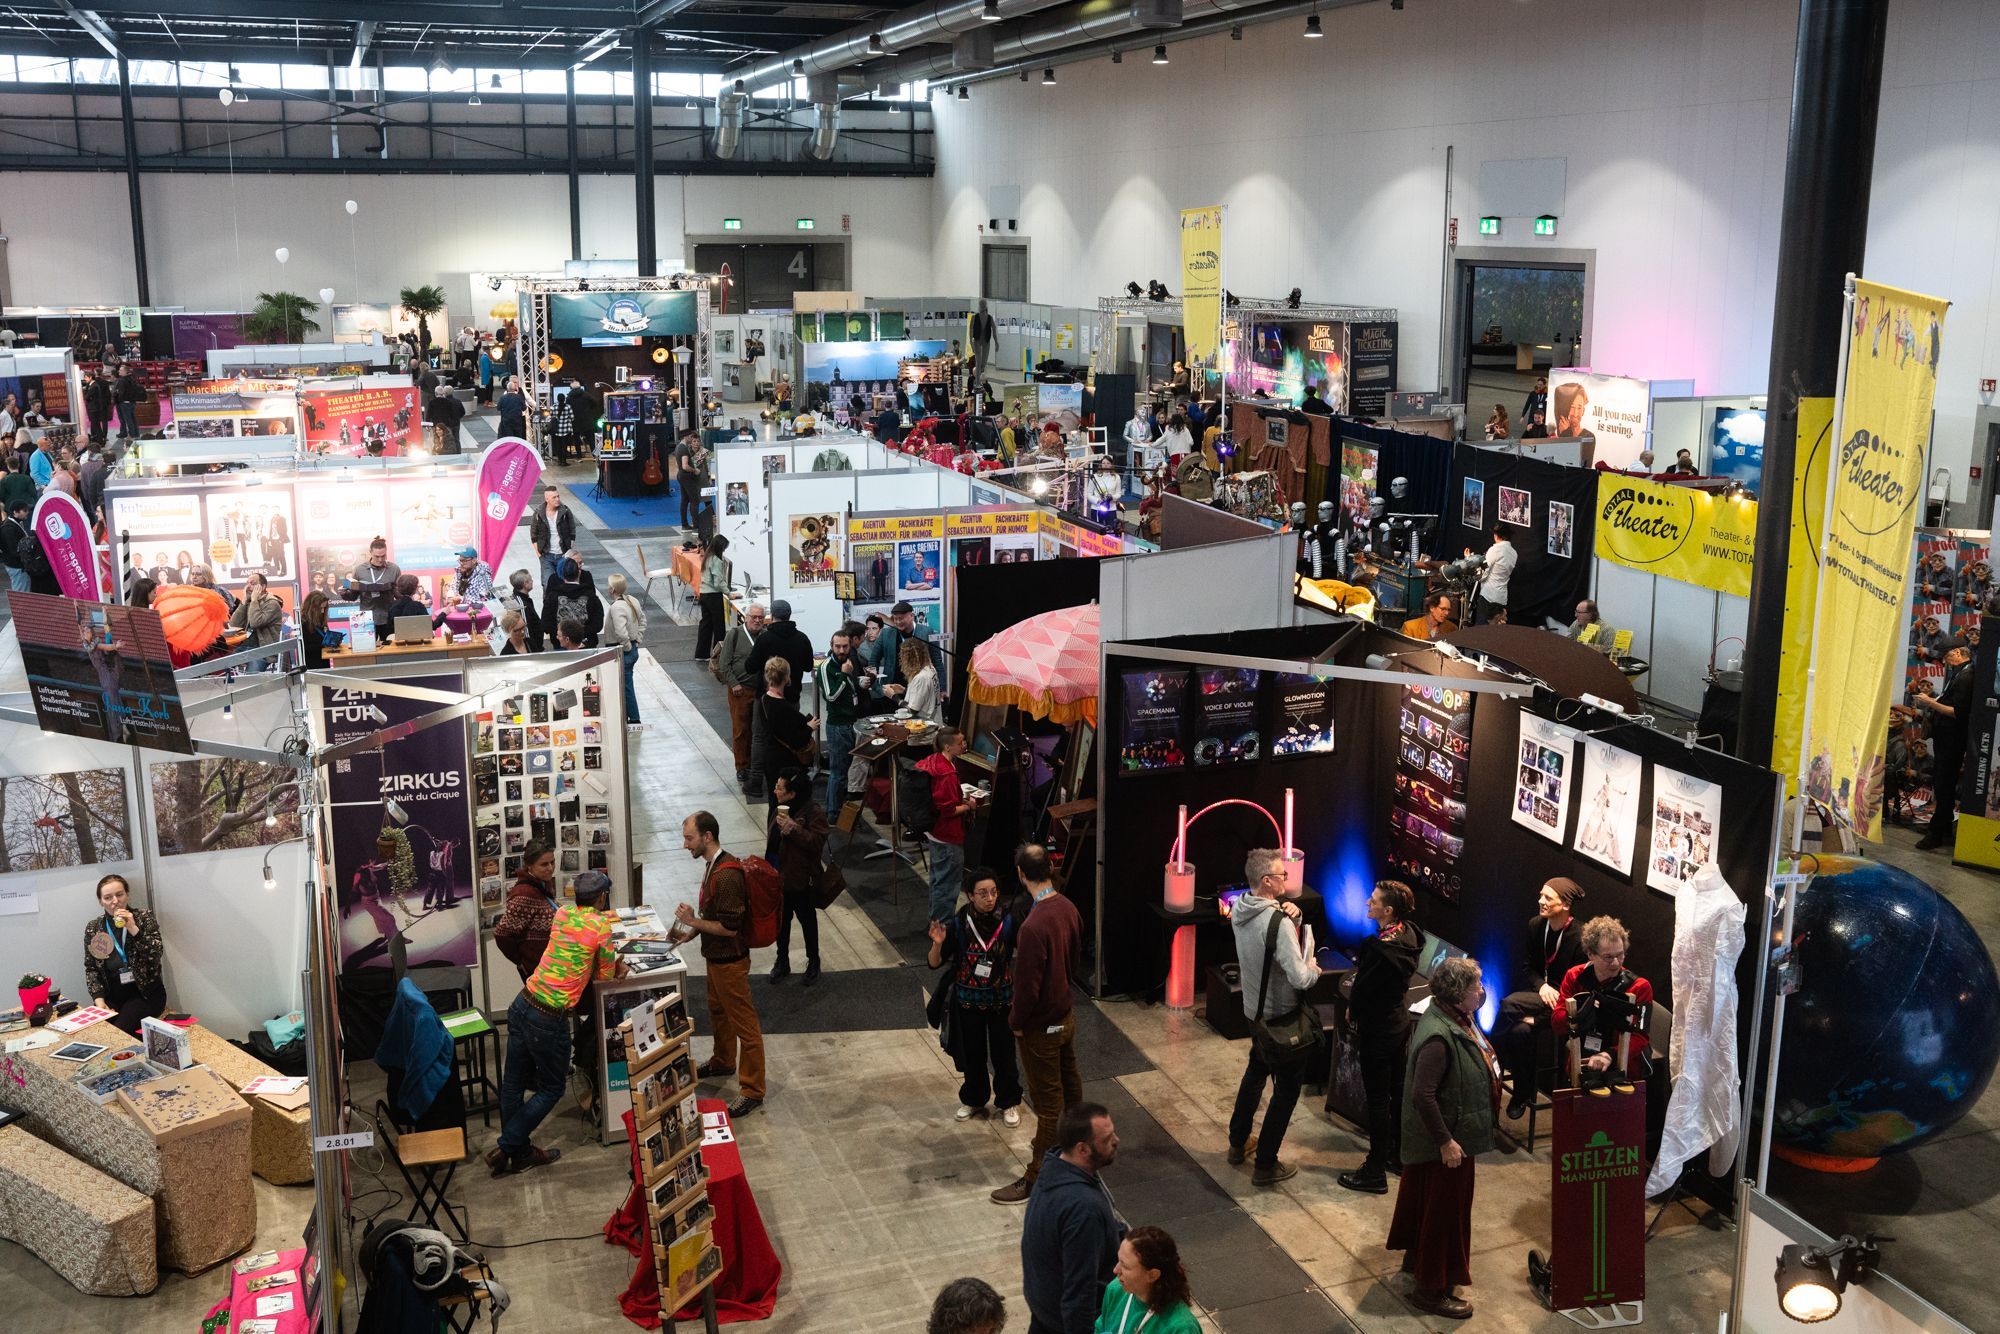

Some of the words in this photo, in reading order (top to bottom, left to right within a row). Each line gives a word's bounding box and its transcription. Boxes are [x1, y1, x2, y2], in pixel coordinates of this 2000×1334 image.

[788, 251, 807, 278] 4
[1363, 328, 1386, 340] MAGIC
[1308, 334, 1334, 350] TICKETING
[1355, 338, 1393, 350] TICKETING
[187, 386, 210, 394] Marc
[327, 393, 364, 405] THEATER
[1592, 406, 1604, 416] All
[1605, 410, 1620, 421] you
[1622, 411, 1642, 424] need
[1597, 420, 1605, 431] is
[1607, 423, 1633, 438] swing.
[499, 455, 520, 494] magenta
[508, 459, 528, 497] ARTISTS
[1849, 450, 1903, 506] theater
[1604, 490, 1632, 517] TOTAAL
[862, 519, 886, 529] AGENTUR
[899, 518, 934, 529] FACHKRÄFTE
[960, 514, 983, 523] AGENTUR
[996, 513, 1029, 523] FACHKRÄFTE
[1613, 503, 1679, 541] theater
[849, 531, 878, 541] SEBASTIAN
[879, 530, 897, 540] KNOCH
[899, 529, 911, 539] FÜR
[912, 529, 933, 539] HUMOR
[947, 526, 975, 536] SEBASTIAN
[976, 525, 993, 535] KNOCH
[996, 525, 1007, 534] FÜR
[1008, 524, 1028, 534] HUMOR
[1710, 526, 1743, 542] Theater-
[1744, 535, 1752, 545] &
[901, 544, 917, 555] JONAS
[917, 541, 939, 553] GREINER
[58, 548, 83, 594] ARTISTS
[65, 542, 89, 590] magenta
[38, 686, 70, 697] Luftartistik
[1284, 692, 1325, 703] GLOWMOTION
[40, 695, 82, 708] Straßentheater
[138, 697, 170, 720] Korb
[72, 709, 90, 718] Zirkus
[1137, 706, 1176, 716] SPACEMANIA
[379, 771, 460, 793] ZIRKUS
[394, 793, 413, 802] Nuit
[416, 792, 428, 800] du
[430, 791, 460, 800] Cirque
[326, 1138, 354, 1148] 2.8.01
[1561, 1146, 1639, 1172] STELZEN
[1560, 1167, 1639, 1183] MANUFAKTUR
